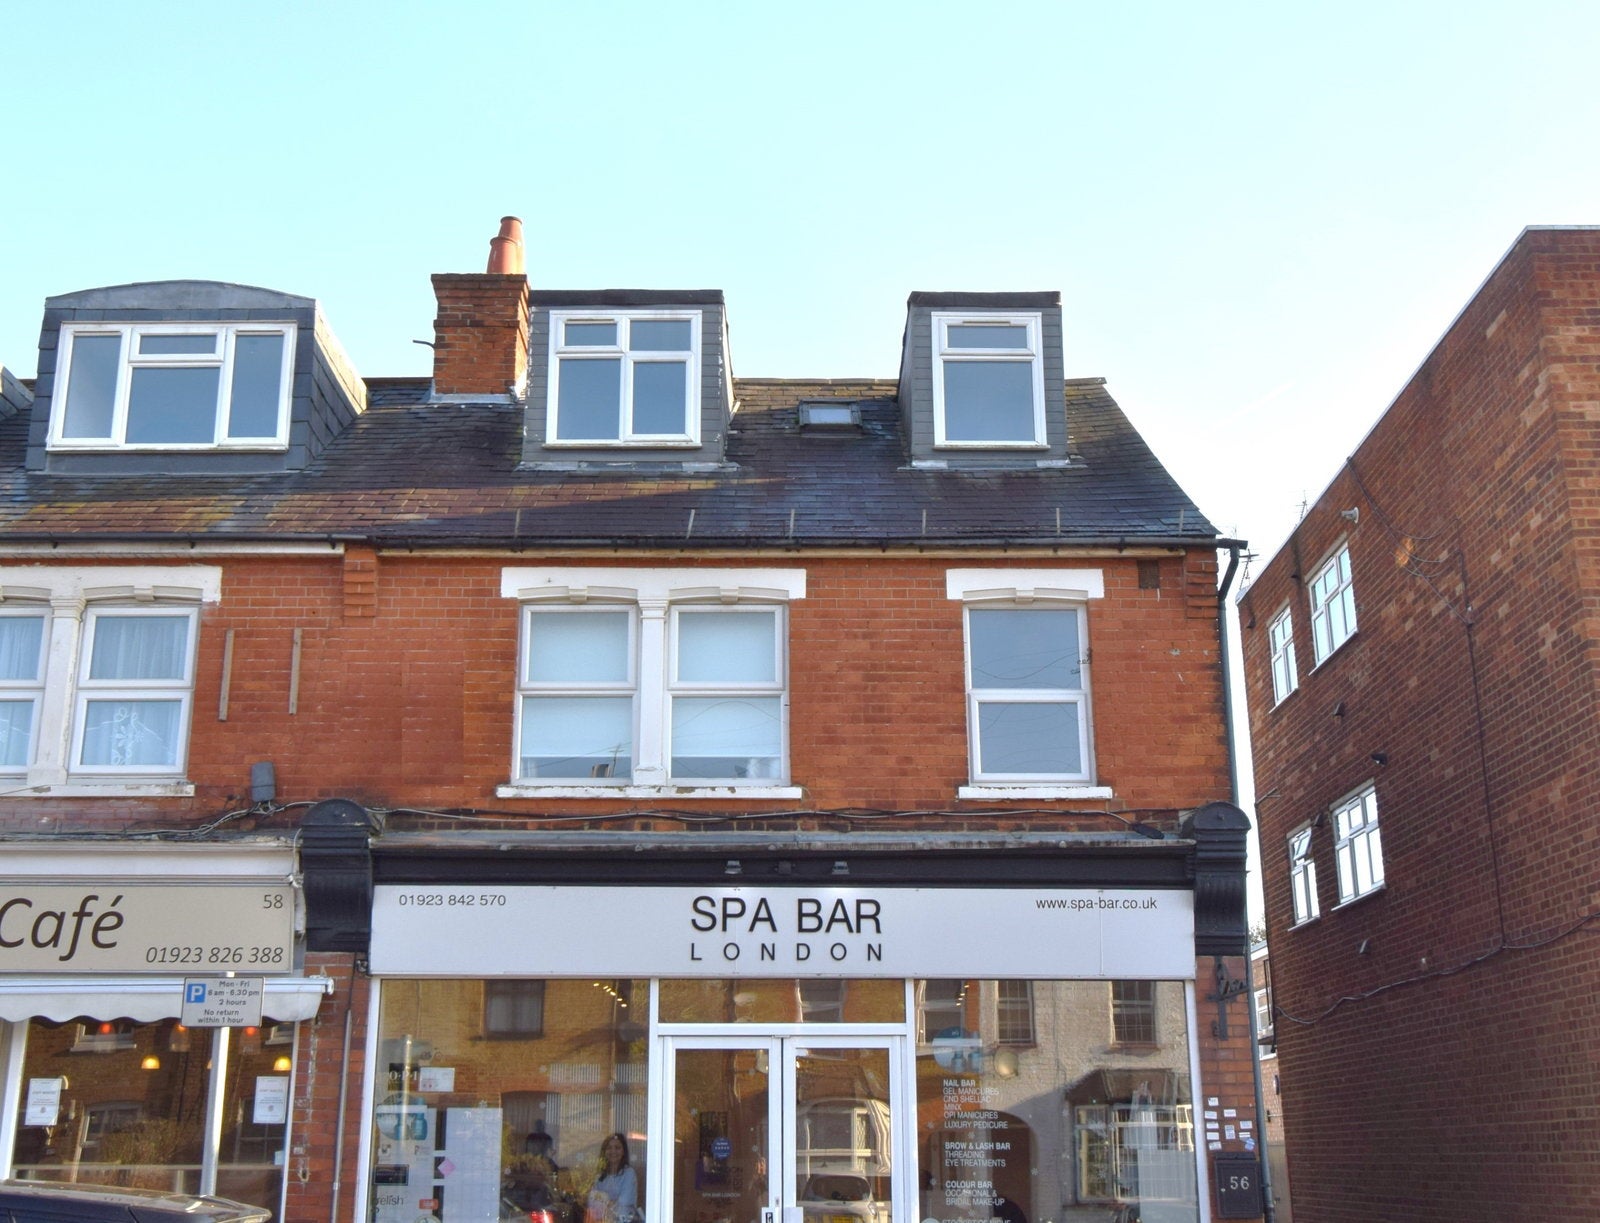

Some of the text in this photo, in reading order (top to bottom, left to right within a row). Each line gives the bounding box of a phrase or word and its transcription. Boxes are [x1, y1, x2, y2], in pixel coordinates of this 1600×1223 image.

[263, 894, 284, 909] 58
[398, 894, 506, 906] 01923 842 570
[1036, 896, 1158, 911] www.spa-bar.co.uk
[691, 895, 881, 934] SPA BAR
[0, 895, 125, 962] Café
[145, 946, 283, 964] 01923 826 388
[690, 942, 882, 961] LONDON
[943, 1079, 976, 1087] NAIL BAR
[942, 1087, 1000, 1096] GEL MANICURES
[943, 1095, 992, 1103] CND SHELLAC
[944, 1111, 999, 1119] OPI MANICURES
[944, 1120, 1009, 1129] LUXURY PEDICURE
[945, 1142, 1011, 1150] BROW & LASH BAR
[945, 1150, 985, 1159] THREADING
[945, 1159, 1006, 1167] EYE TREATMENTS
[1230, 1176, 1250, 1190] 56
[972, 1198, 1006, 1206] MAKE-UP
